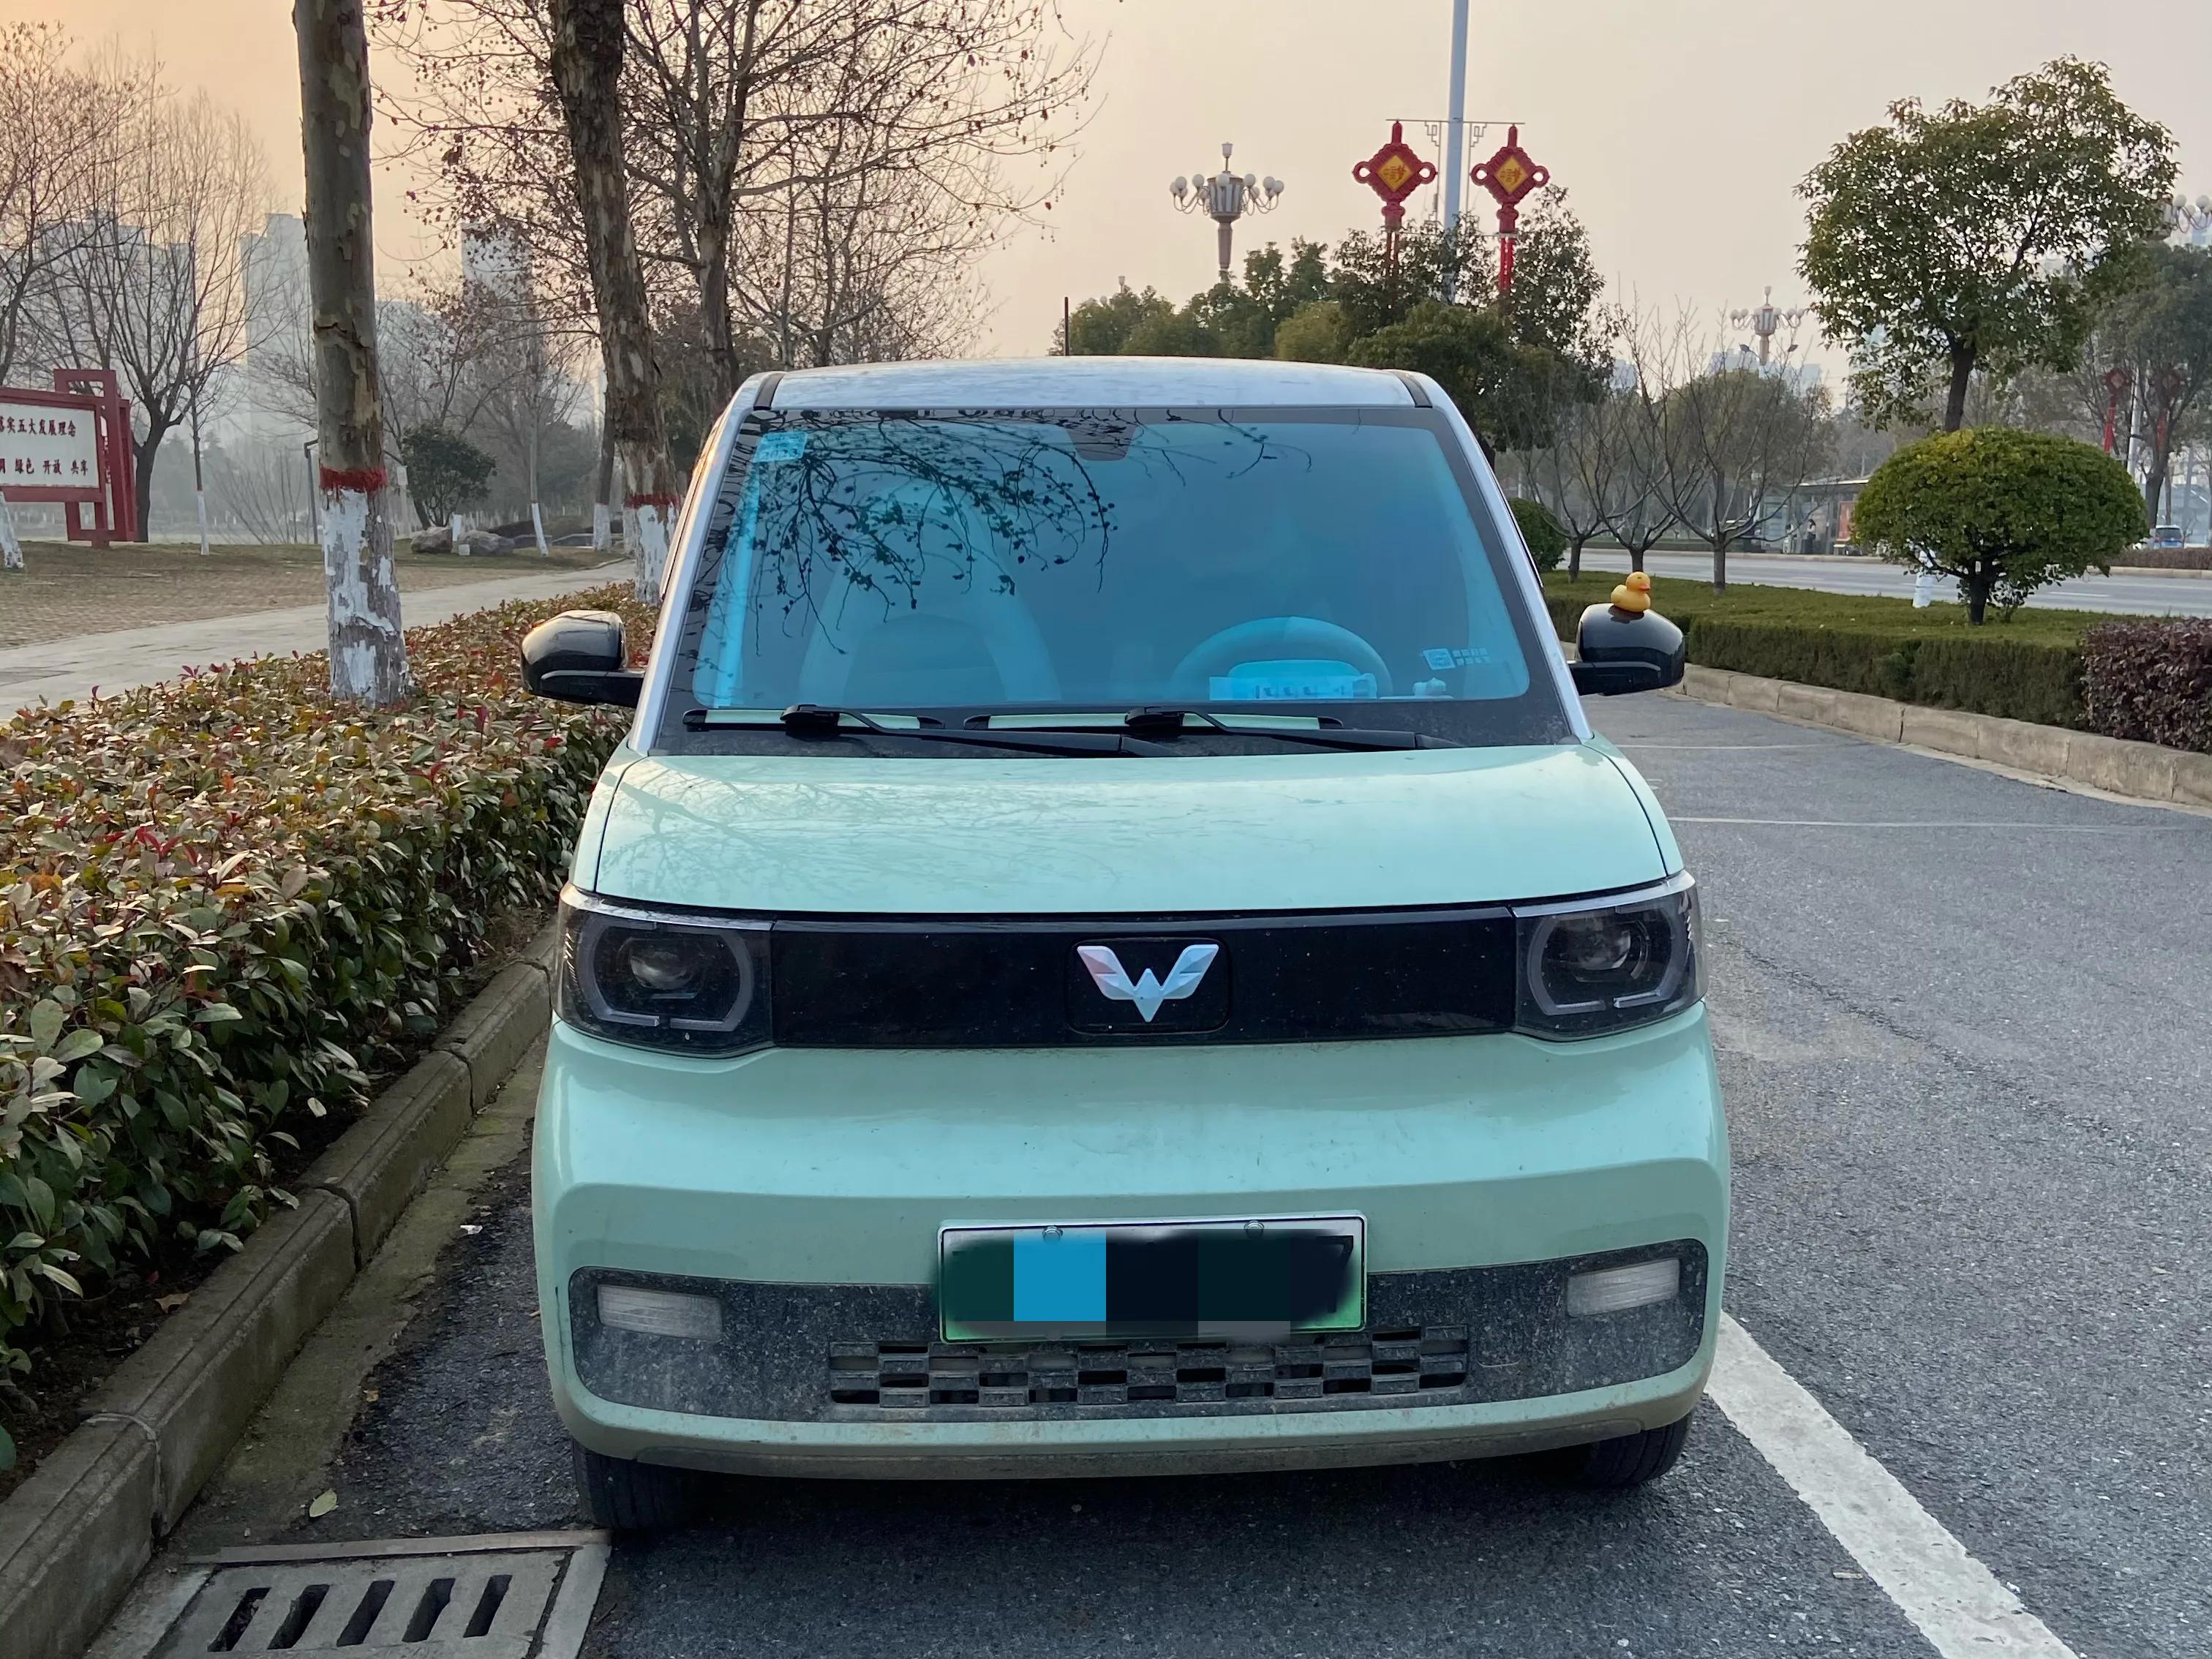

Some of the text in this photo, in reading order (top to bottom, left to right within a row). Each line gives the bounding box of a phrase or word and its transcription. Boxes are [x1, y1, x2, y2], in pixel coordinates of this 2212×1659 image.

[15, 457, 34, 475] 绿色
[42, 459, 62, 475] 开放
[70, 459, 89, 475] 共享
